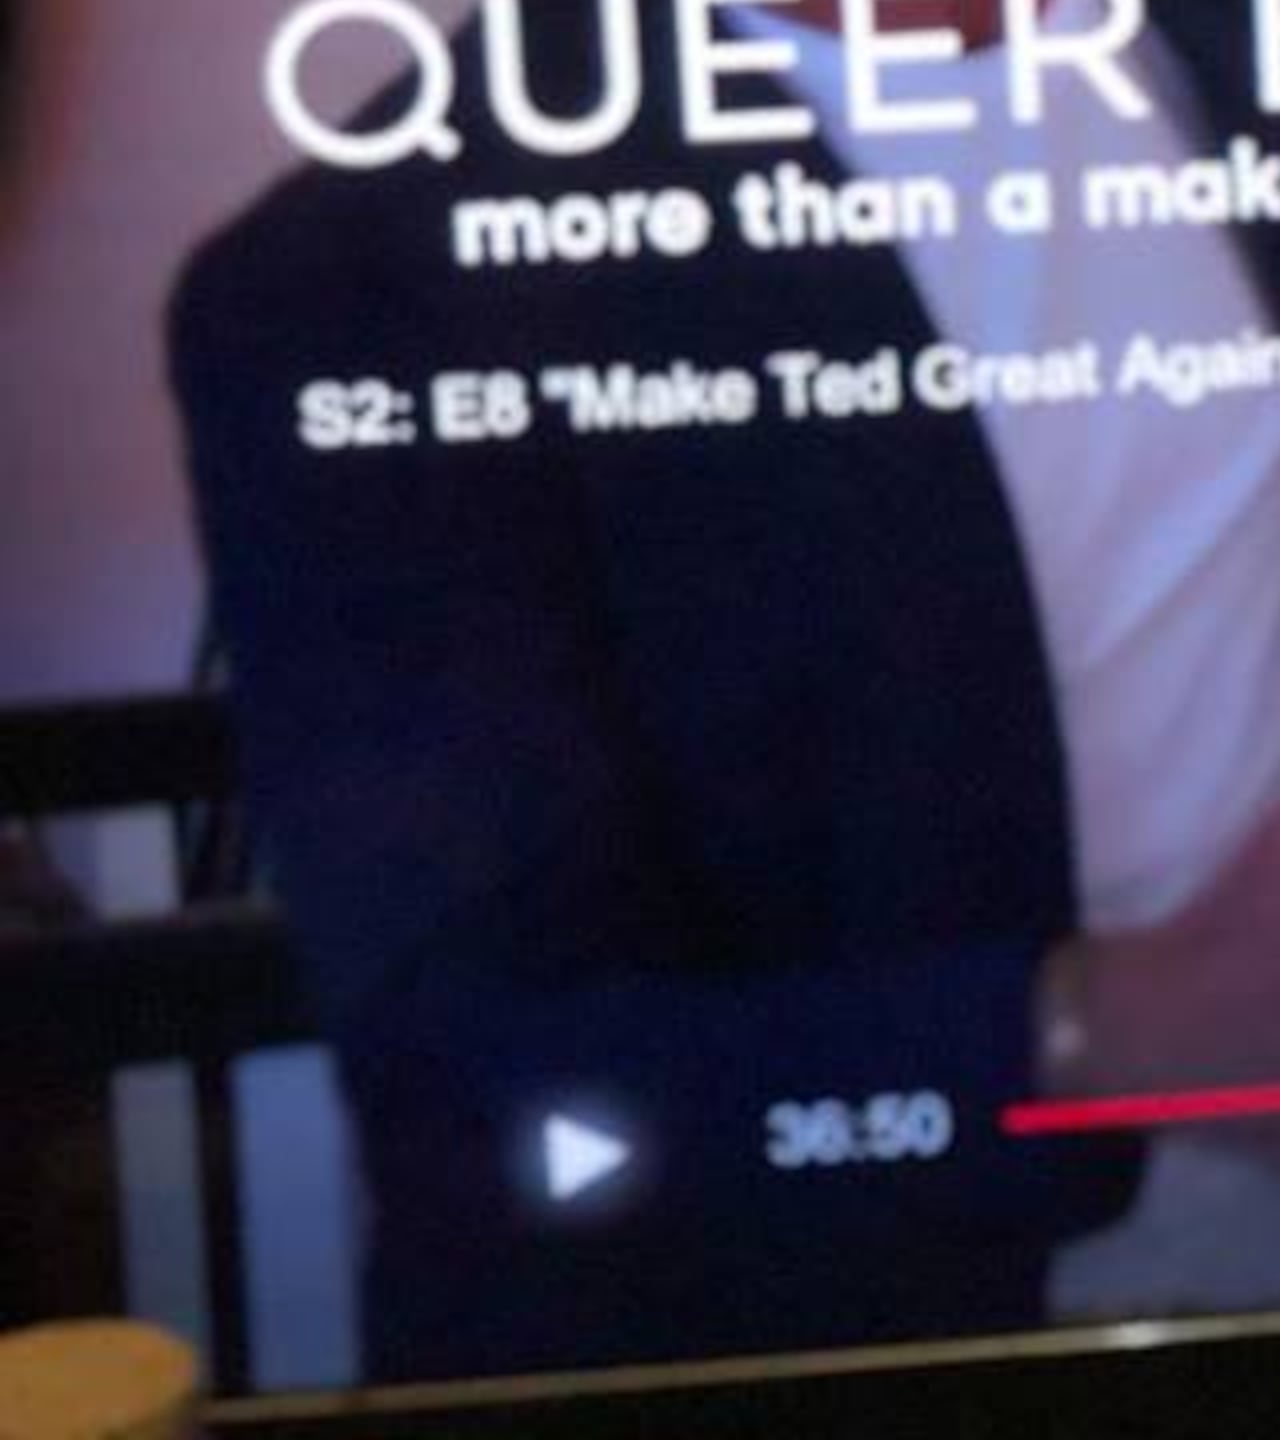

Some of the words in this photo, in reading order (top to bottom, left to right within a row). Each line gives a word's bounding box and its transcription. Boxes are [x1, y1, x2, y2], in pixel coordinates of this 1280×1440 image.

[453, 185, 711, 266] more
[734, 162, 957, 250] than
[987, 172, 1053, 233] a
[297, 379, 415, 451] S2:
[433, 372, 528, 442] E8
[541, 360, 753, 433] "Make
[766, 348, 900, 417] Ted
[915, 339, 1100, 409] Great
